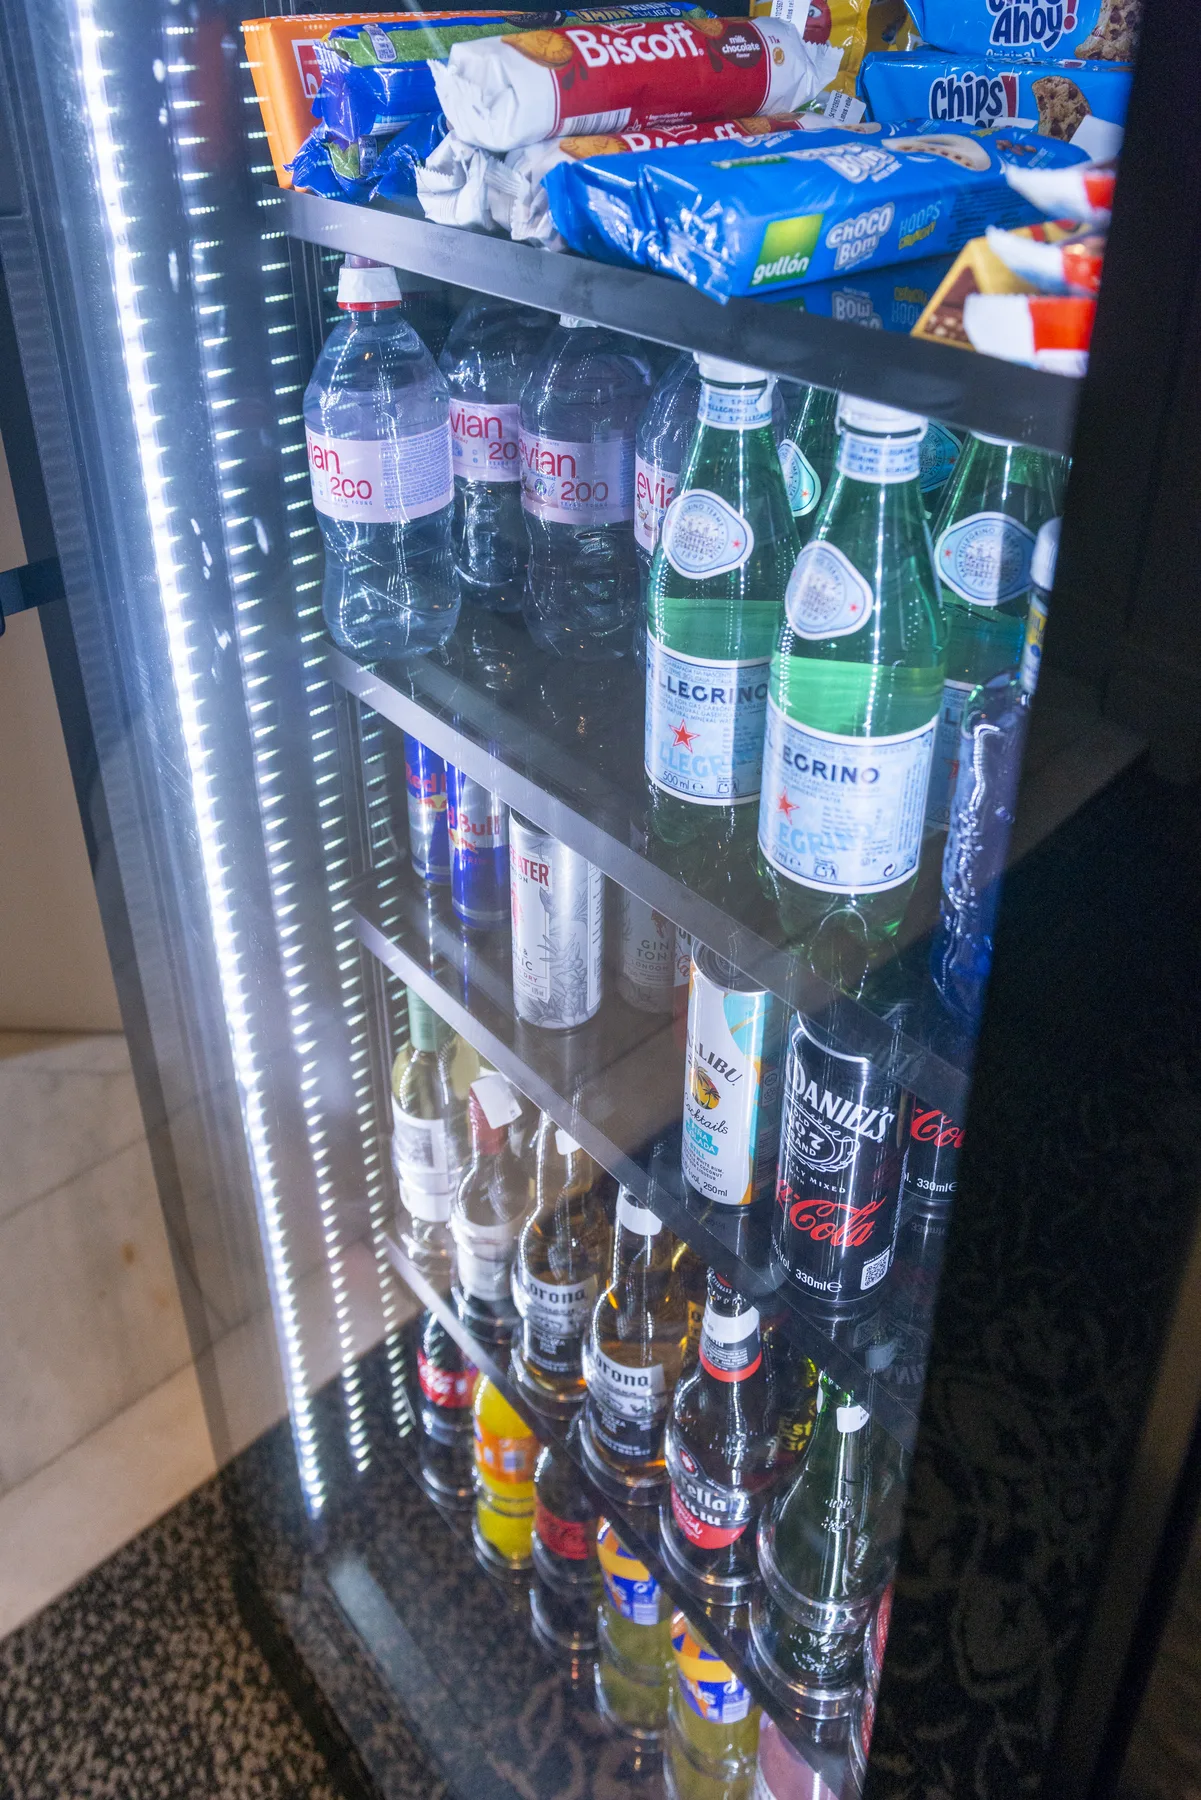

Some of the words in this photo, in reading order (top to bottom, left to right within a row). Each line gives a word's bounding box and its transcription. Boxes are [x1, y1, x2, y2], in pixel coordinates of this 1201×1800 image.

[565, 22, 699, 68] Biscoff
[722, 42, 760, 54] chocolate
[729, 35, 747, 44] milk
[900, 200, 943, 237] HOOPS
[752, 252, 810, 285] gullón
[330, 477, 373, 500] 200
[560, 480, 609, 502] 200
[663, 770, 678, 786] 500
[680, 779, 690, 790] ml
[459, 813, 500, 836] Bull
[641, 939, 669, 951] GIN
[523, 972, 538, 983] DRY
[808, 1131, 825, 1151] 7
[809, 1177, 847, 1194] MIXED
